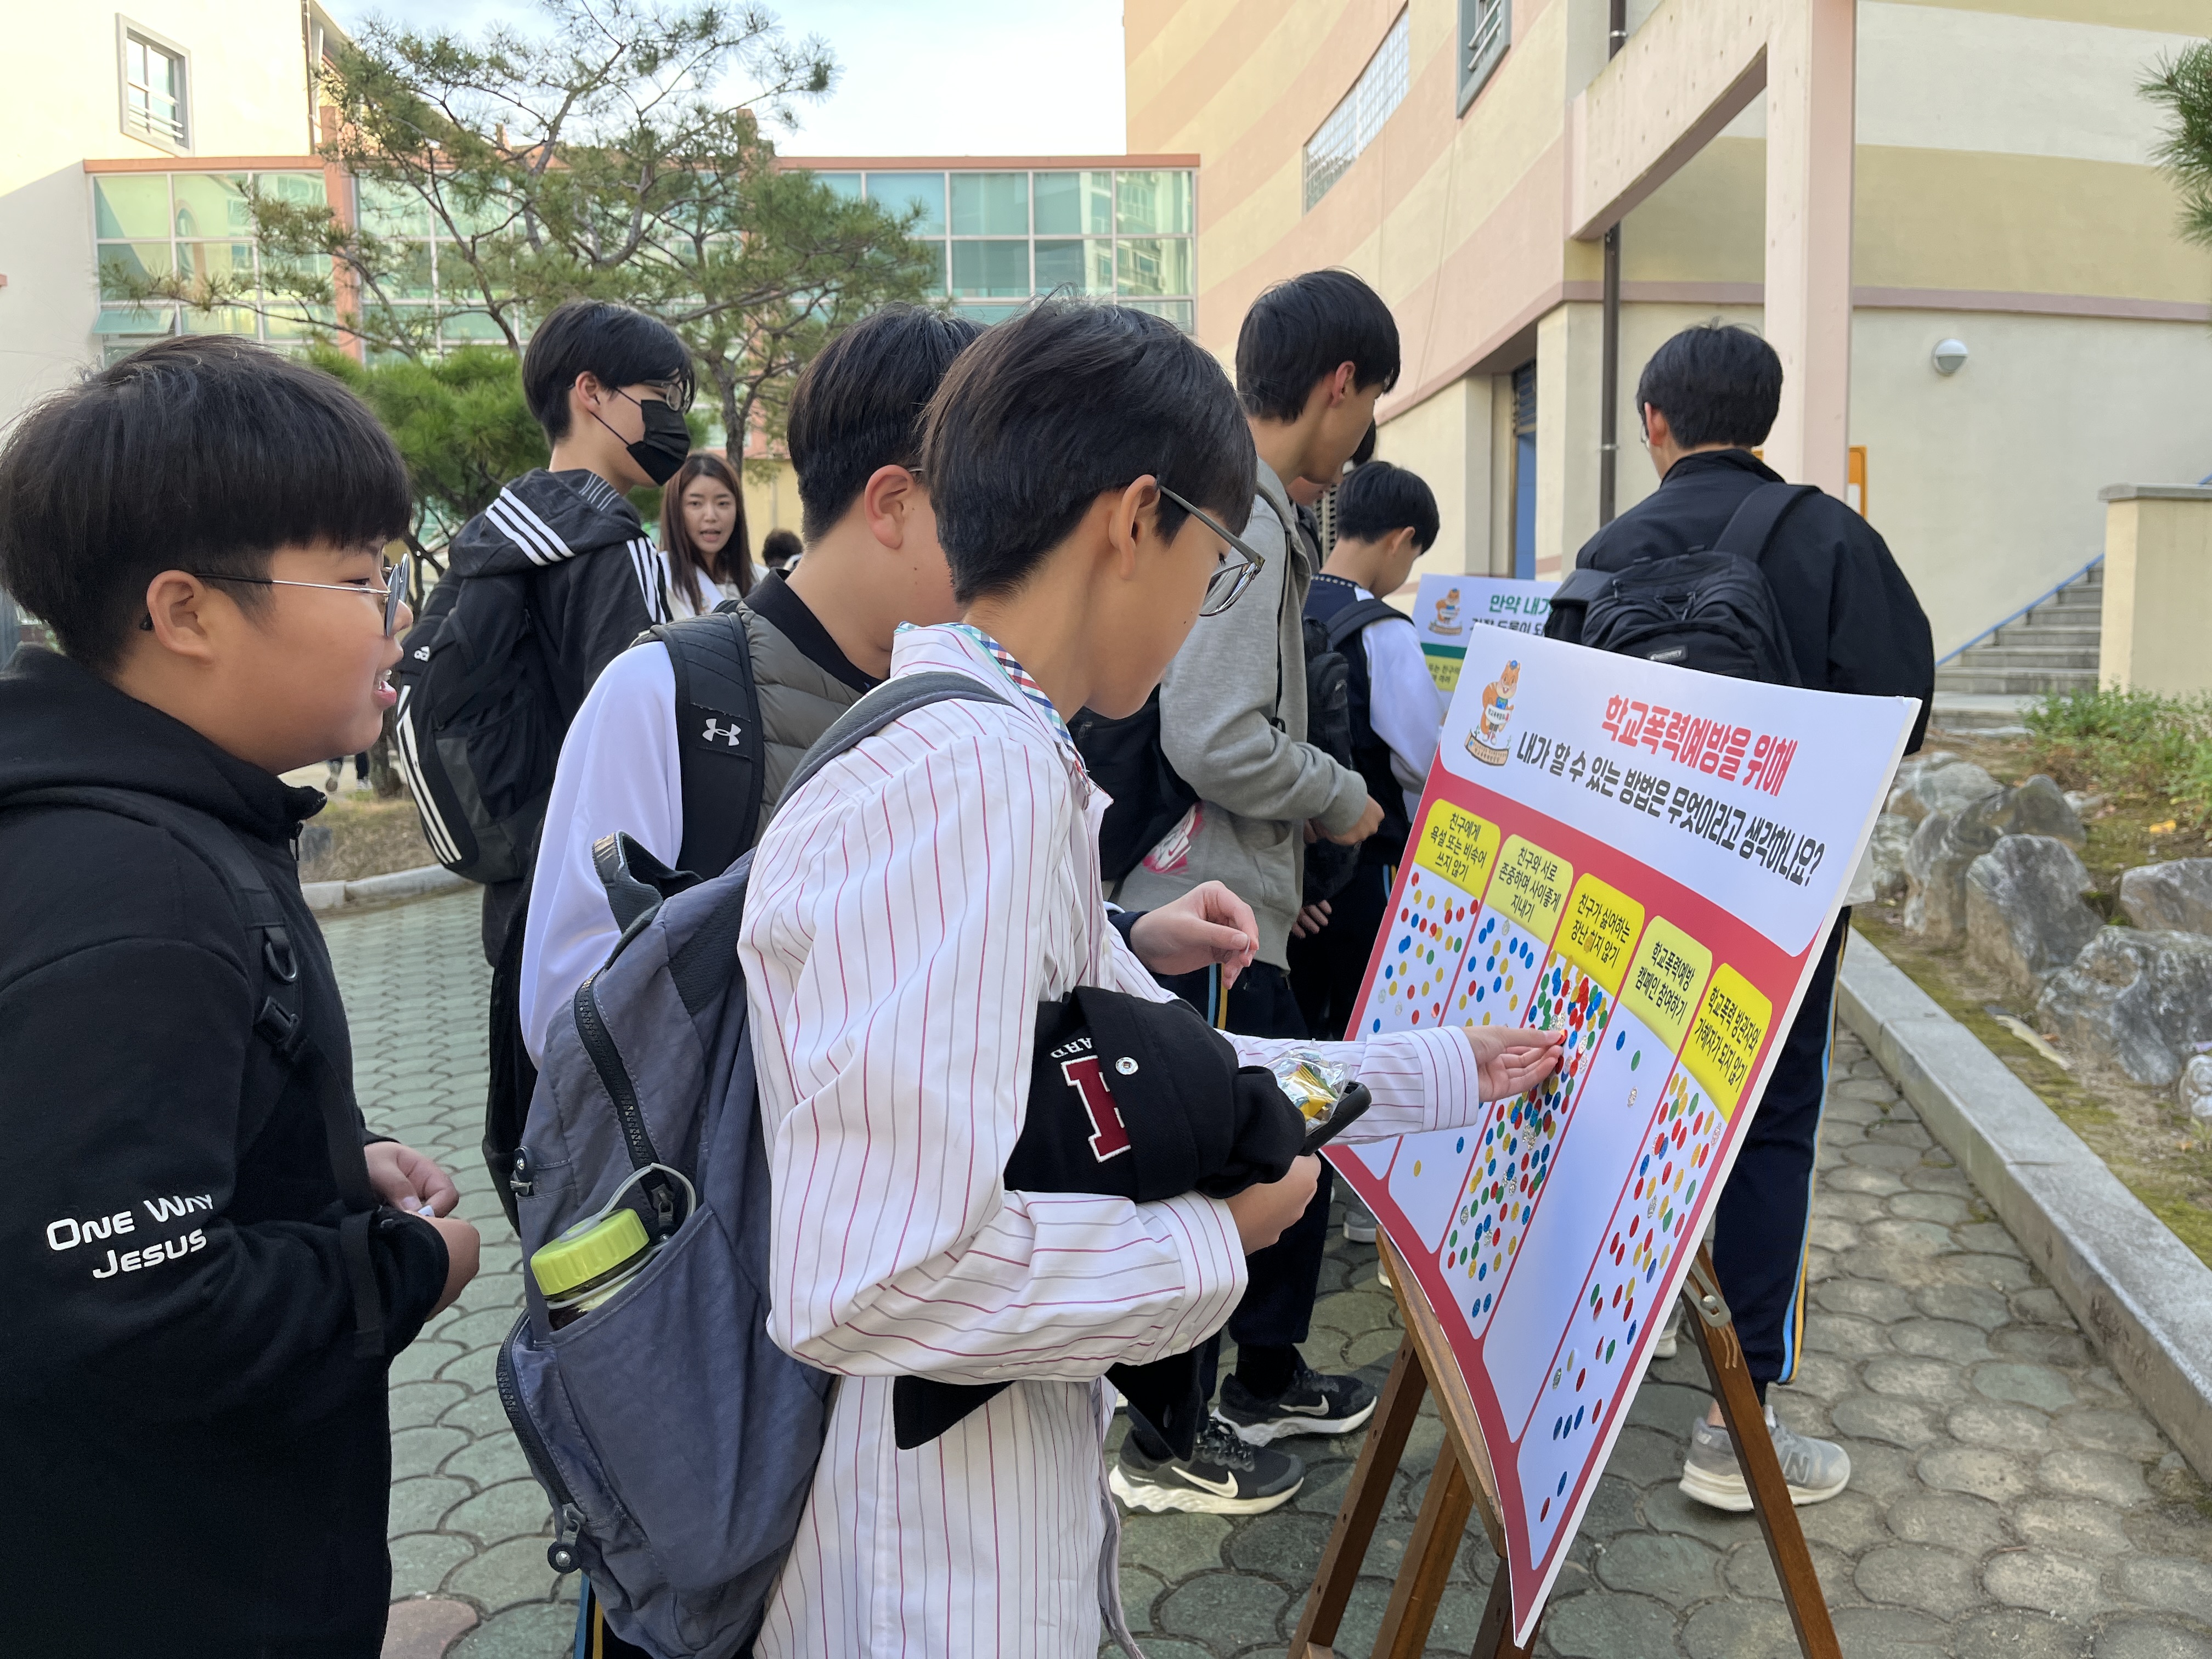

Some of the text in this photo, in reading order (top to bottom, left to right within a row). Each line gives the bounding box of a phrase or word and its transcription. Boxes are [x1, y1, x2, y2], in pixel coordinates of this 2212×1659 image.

[1489, 594, 1521, 613] 만약
[1601, 694, 1798, 797] 학교폭력예방을 위해
[1449, 812, 1481, 842] 친구에게
[1517, 731, 1552, 769] 내가
[1549, 742, 1571, 776] 할
[1569, 751, 1586, 782] 수
[1585, 757, 1621, 798] 있는
[1619, 768, 1671, 817] 방법은
[1668, 787, 1746, 850] 무엇이라고
[1739, 816, 1825, 887] 생각하나요?
[1431, 826, 1487, 869] 욕설 또는 비속어
[1435, 851, 1469, 882] 쓰지 않기
[1517, 847, 1558, 882] 친구와 서로
[1499, 862, 1561, 913] 존중하며 사이좋게
[1511, 894, 1535, 923] 지내기
[1571, 919, 1589, 945] 장난
[1601, 941, 1620, 969] 않기
[1577, 893, 1630, 944] 친구가 싫어하는
[1651, 941, 1696, 992] 학교폭력예방
[1635, 966, 1688, 1026] 캠페인 참여하기
[1708, 986, 1761, 1058] 학교폭력 방관자와
[1695, 1018, 1748, 1093] 가해자가 되지 않기
